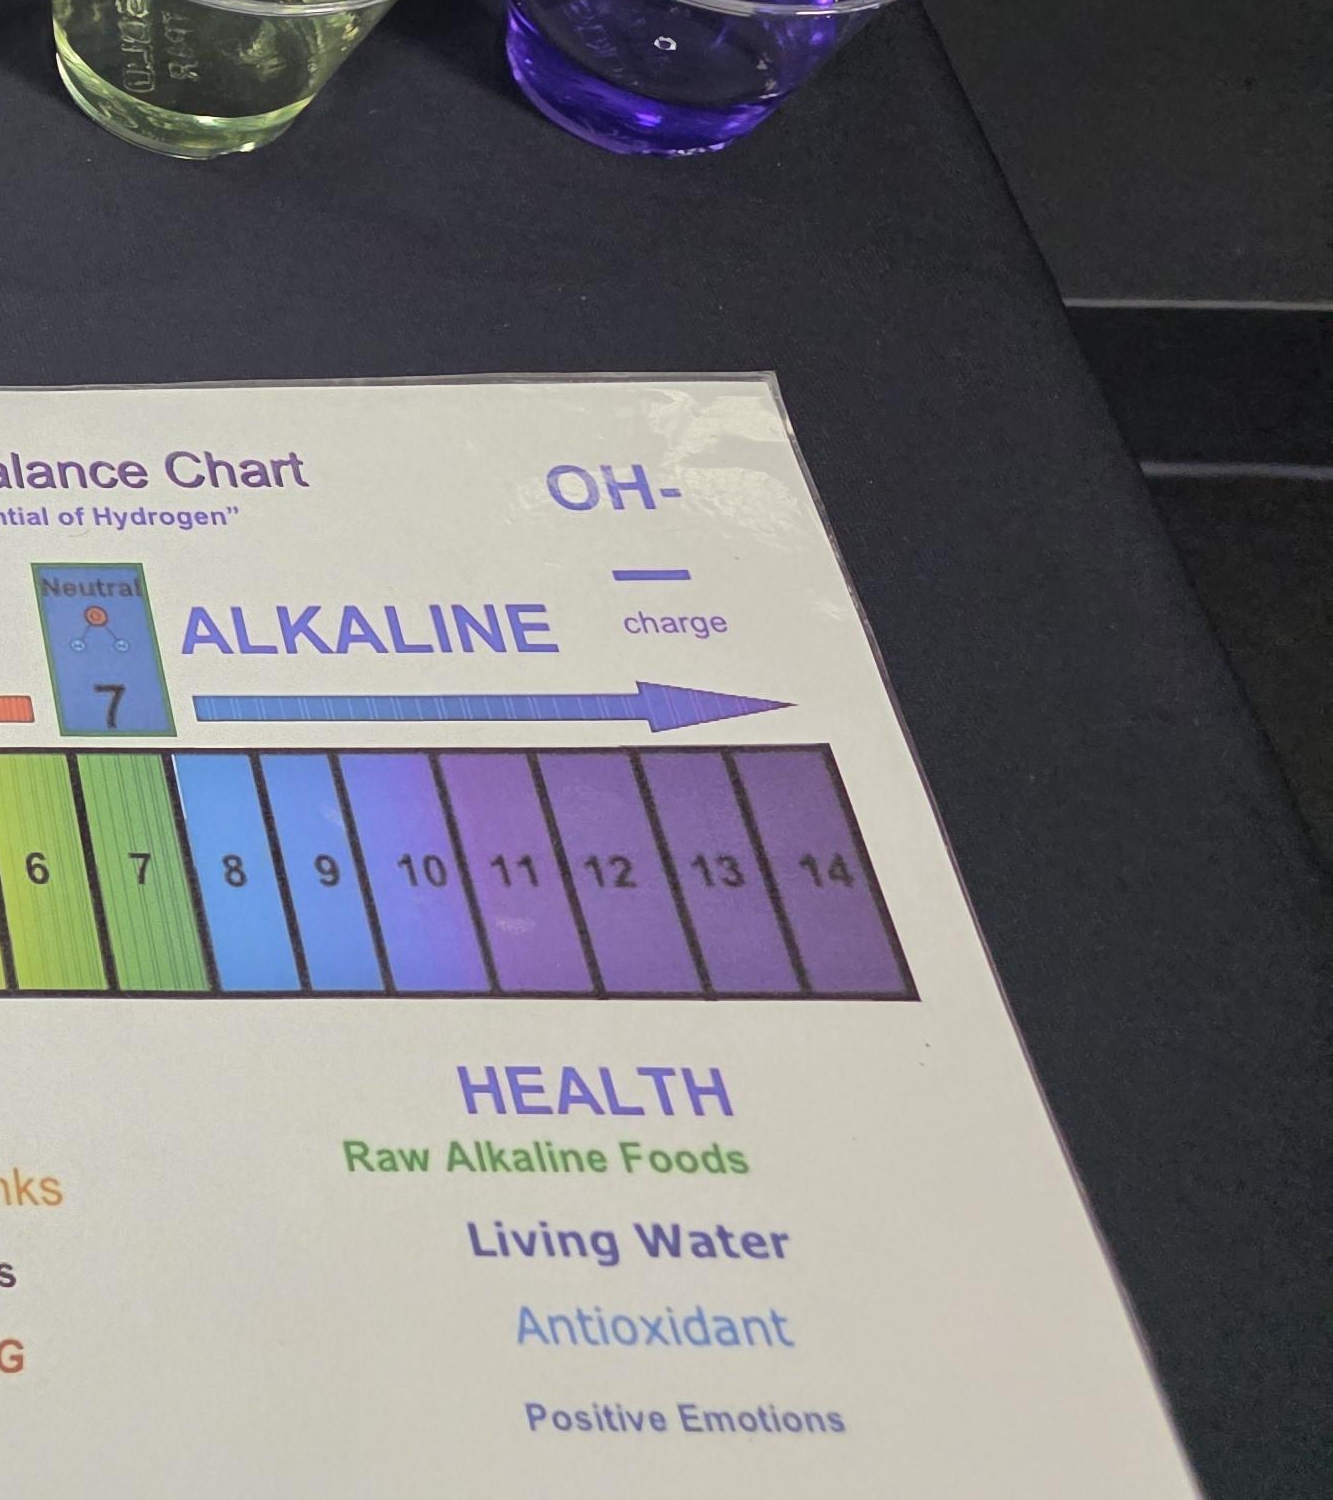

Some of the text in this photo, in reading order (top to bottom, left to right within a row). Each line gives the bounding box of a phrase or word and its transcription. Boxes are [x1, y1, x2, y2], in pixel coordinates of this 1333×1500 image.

[164, 451, 309, 489] Chart
[546, 464, 681, 512] OH-
[57, 506, 84, 526] of
[91, 506, 239, 531] Hydrogen”
[41, 578, 143, 597] Neutral
[181, 603, 560, 655] ALKALINE
[623, 611, 728, 640] charge
[93, 683, 126, 729] 7
[25, 853, 50, 884] 6
[127, 853, 152, 884] 7
[222, 855, 247, 887] 8
[314, 855, 340, 886] 9
[397, 854, 448, 887] 10
[490, 855, 539, 887] 11
[584, 855, 636, 887] 12
[692, 855, 746, 887] 13
[799, 854, 855, 888] 14
[457, 1065, 734, 1117] HEALTH
[342, 1139, 750, 1175] Raw Alkaline Foods
[467, 1220, 789, 1268] Living Water
[517, 1305, 795, 1348] Antioxidant
[524, 1401, 846, 1434] Positive Emotions
